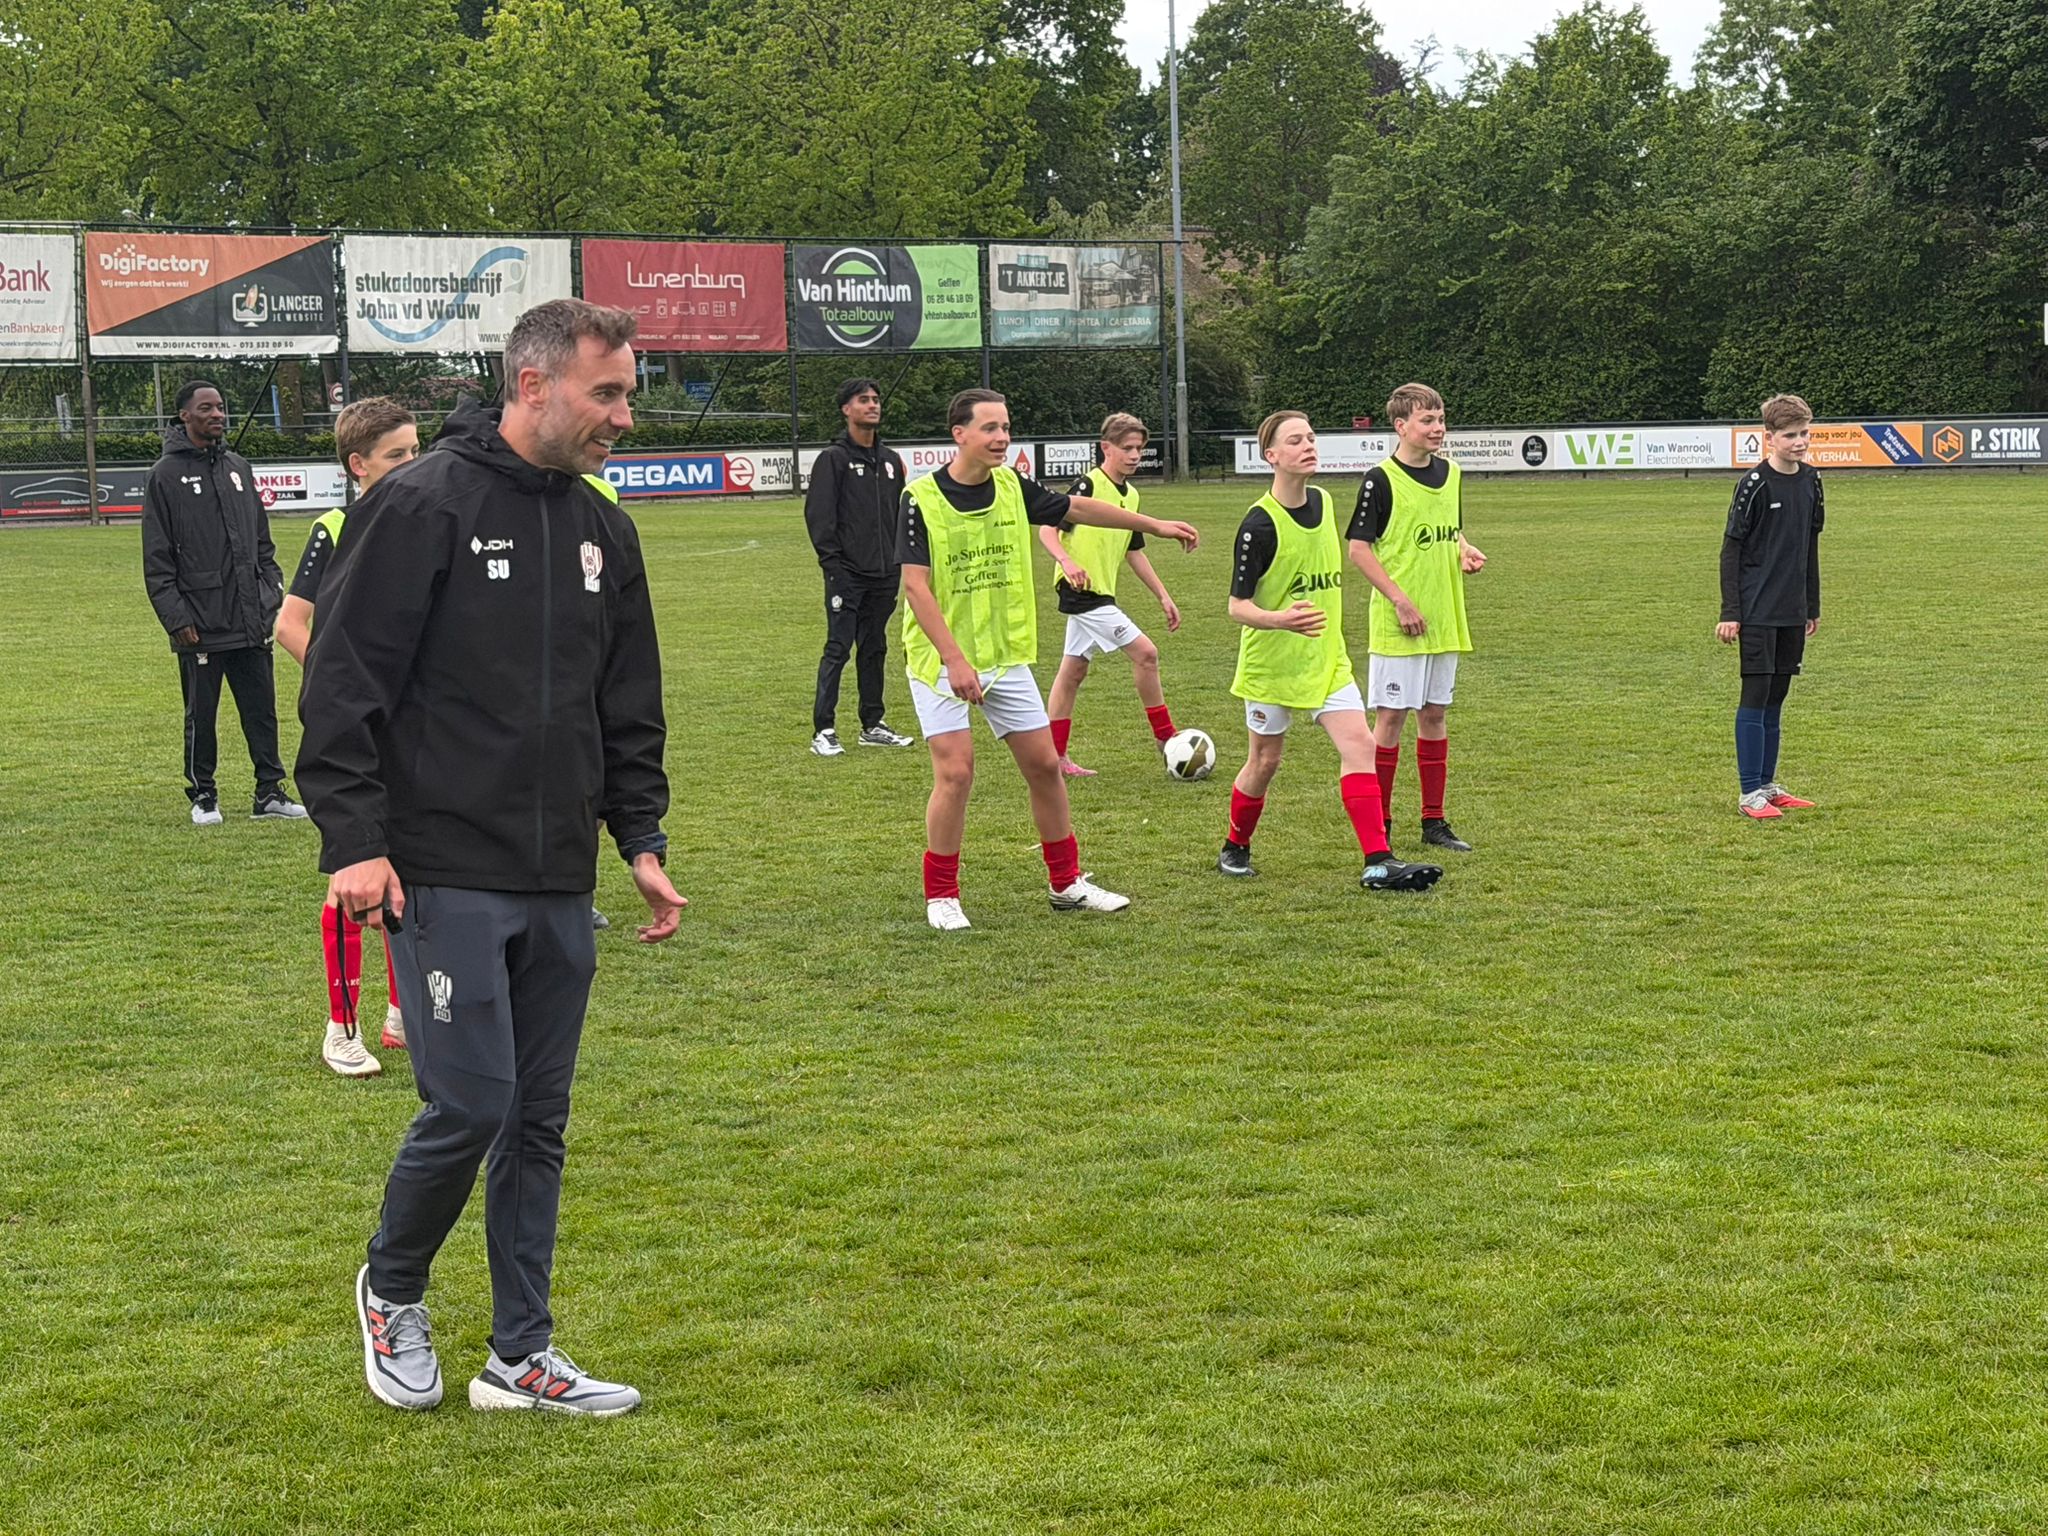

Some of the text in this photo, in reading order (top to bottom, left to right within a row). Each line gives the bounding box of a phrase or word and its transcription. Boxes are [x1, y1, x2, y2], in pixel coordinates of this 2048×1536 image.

[100, 251, 209, 276] DigiFactory
[101, 280, 113, 288] Wij
[355, 271, 503, 297] stukadoorsbedrijf
[627, 261, 745, 299] Lunenburg
[937, 277, 960, 288] Geffen
[1002, 269, 1066, 288] 'T AKKERTJE
[797, 278, 912, 302] Van Hinthum
[271, 295, 323, 311] LANCEER
[356, 298, 480, 320] John vd Wouw
[272, 313, 324, 322] JE WEBSITE
[819, 306, 895, 322] Totaalbouw
[999, 317, 1025, 326] LUNCH
[1035, 317, 1060, 326] DINER
[1109, 317, 1152, 326] CAFETARIA
[136, 341, 231, 350] WWW.DIGIFACTORY.NL
[1849, 431, 1862, 439] jou
[1971, 428, 2041, 451] P. STRIK
[1449, 440, 1478, 448] SNACKS
[1646, 443, 1711, 455] Van Wanrooij
[1048, 445, 1086, 458] Danny's
[1452, 450, 1490, 458] WINNENDE
[1492, 449, 1514, 457] GOAL!
[1816, 451, 1862, 462] VERHAAL
[762, 457, 793, 467] MARK
[1646, 455, 1716, 465] Electrotechniek
[604, 464, 713, 487] OEGAM
[777, 464, 796, 475] VA
[1045, 462, 1091, 477] EETERIJ
[483, 539, 514, 551] JDH
[945, 543, 1014, 566] Jo Spierings
[487, 559, 510, 579] SU
[964, 570, 998, 584] Geffen
[1308, 571, 1342, 592] JAKO
